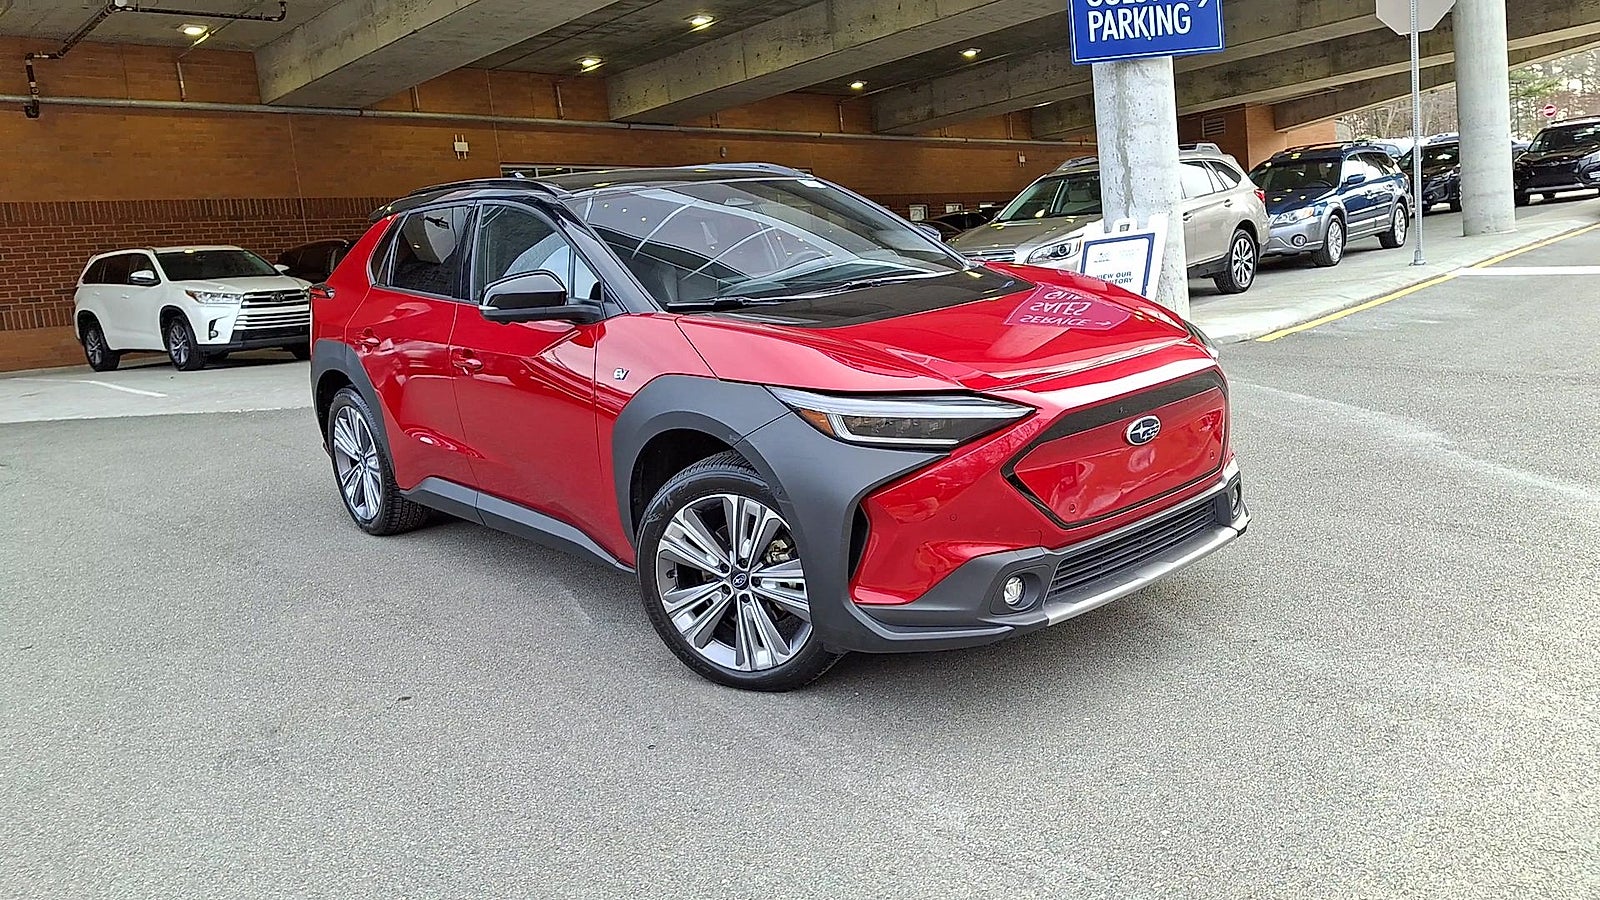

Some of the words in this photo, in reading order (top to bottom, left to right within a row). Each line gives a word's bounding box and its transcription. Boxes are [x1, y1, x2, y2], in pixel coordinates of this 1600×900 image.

[1087, 2, 1192, 42] PARKING
[1116, 271, 1132, 279] OUR
[613, 367, 630, 380] EV
